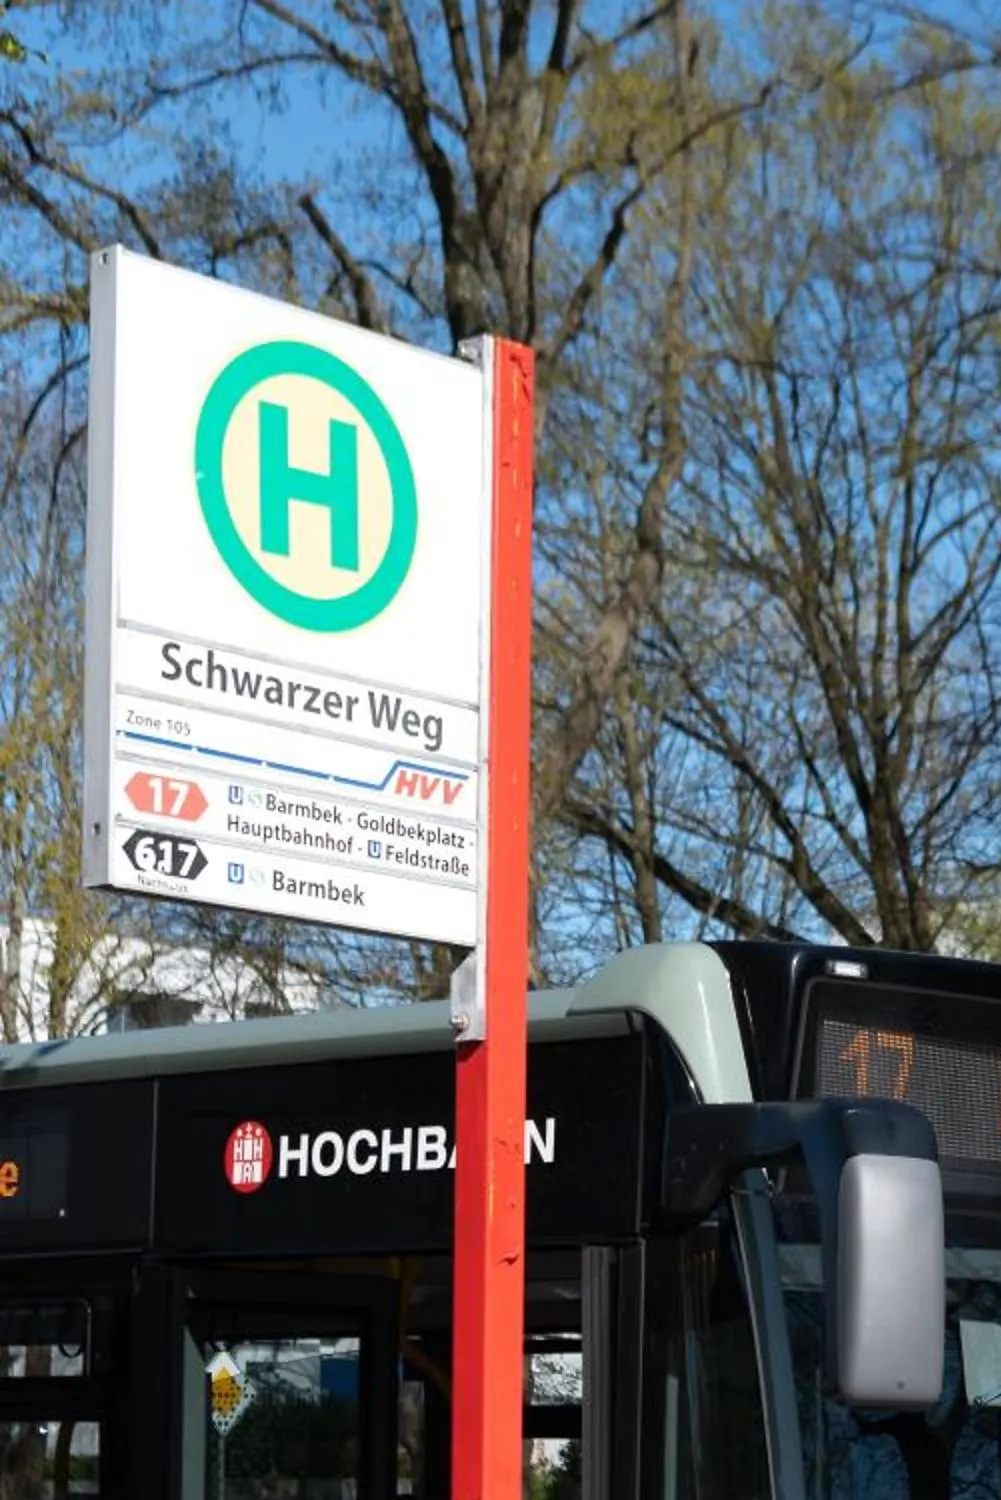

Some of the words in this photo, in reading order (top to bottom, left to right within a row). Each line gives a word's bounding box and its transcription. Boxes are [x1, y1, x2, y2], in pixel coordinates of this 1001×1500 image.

[259, 400, 359, 572] H
[126, 709, 162, 731] Zone
[161, 642, 359, 721] Schwarzer
[368, 691, 443, 751] Weg
[148, 780, 188, 822] 17
[394, 770, 464, 805] HVV
[227, 817, 353, 854] Hauptbahnhof
[385, 847, 470, 877] Feldstraße
[265, 794, 342, 825] Barmbek
[357, 813, 465, 850] Goldbekplatz
[272, 871, 365, 906] Barmbek
[278, 1118, 556, 1179] HOCHBN
